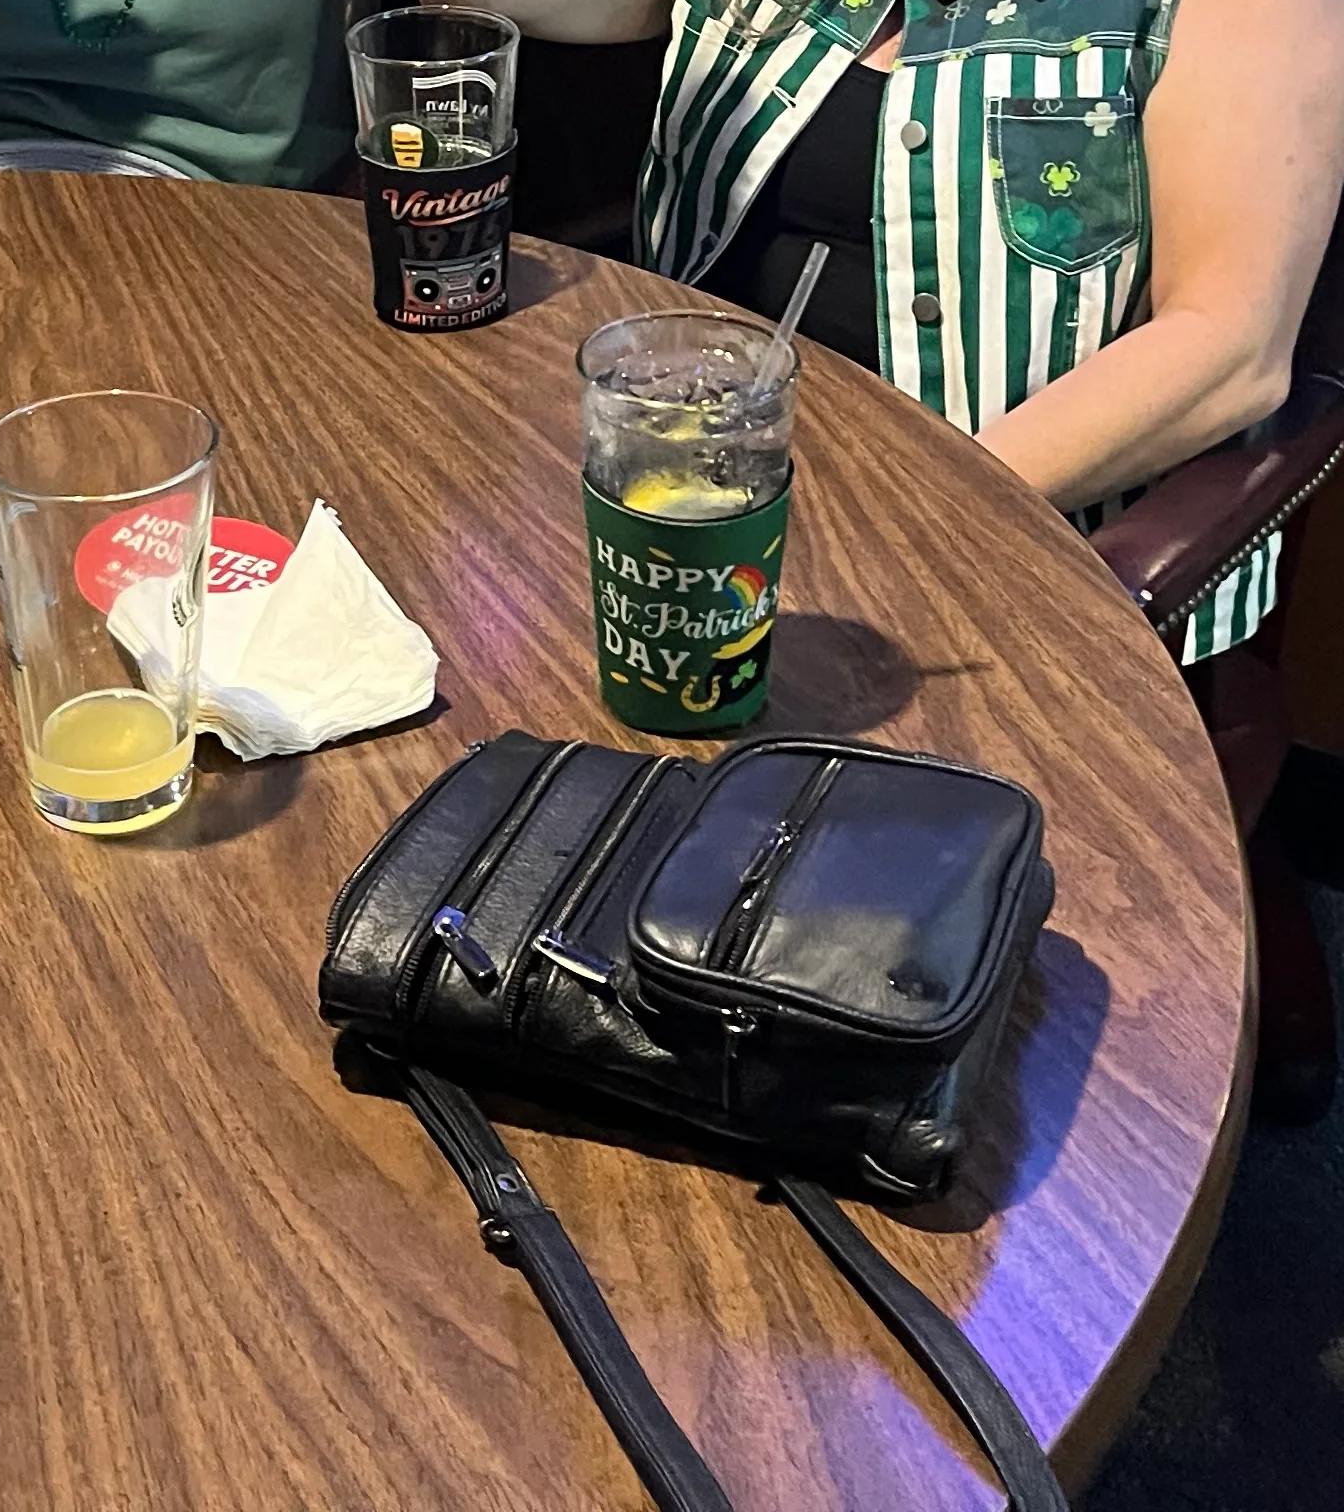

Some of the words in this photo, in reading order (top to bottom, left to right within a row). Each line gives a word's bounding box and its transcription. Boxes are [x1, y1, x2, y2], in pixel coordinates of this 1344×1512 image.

[382, 174, 511, 223] Vintage
[394, 309, 460, 328] LIMITED
[594, 534, 735, 593] HAPPY
[598, 579, 640, 632] St.
[603, 617, 691, 681] DAY
